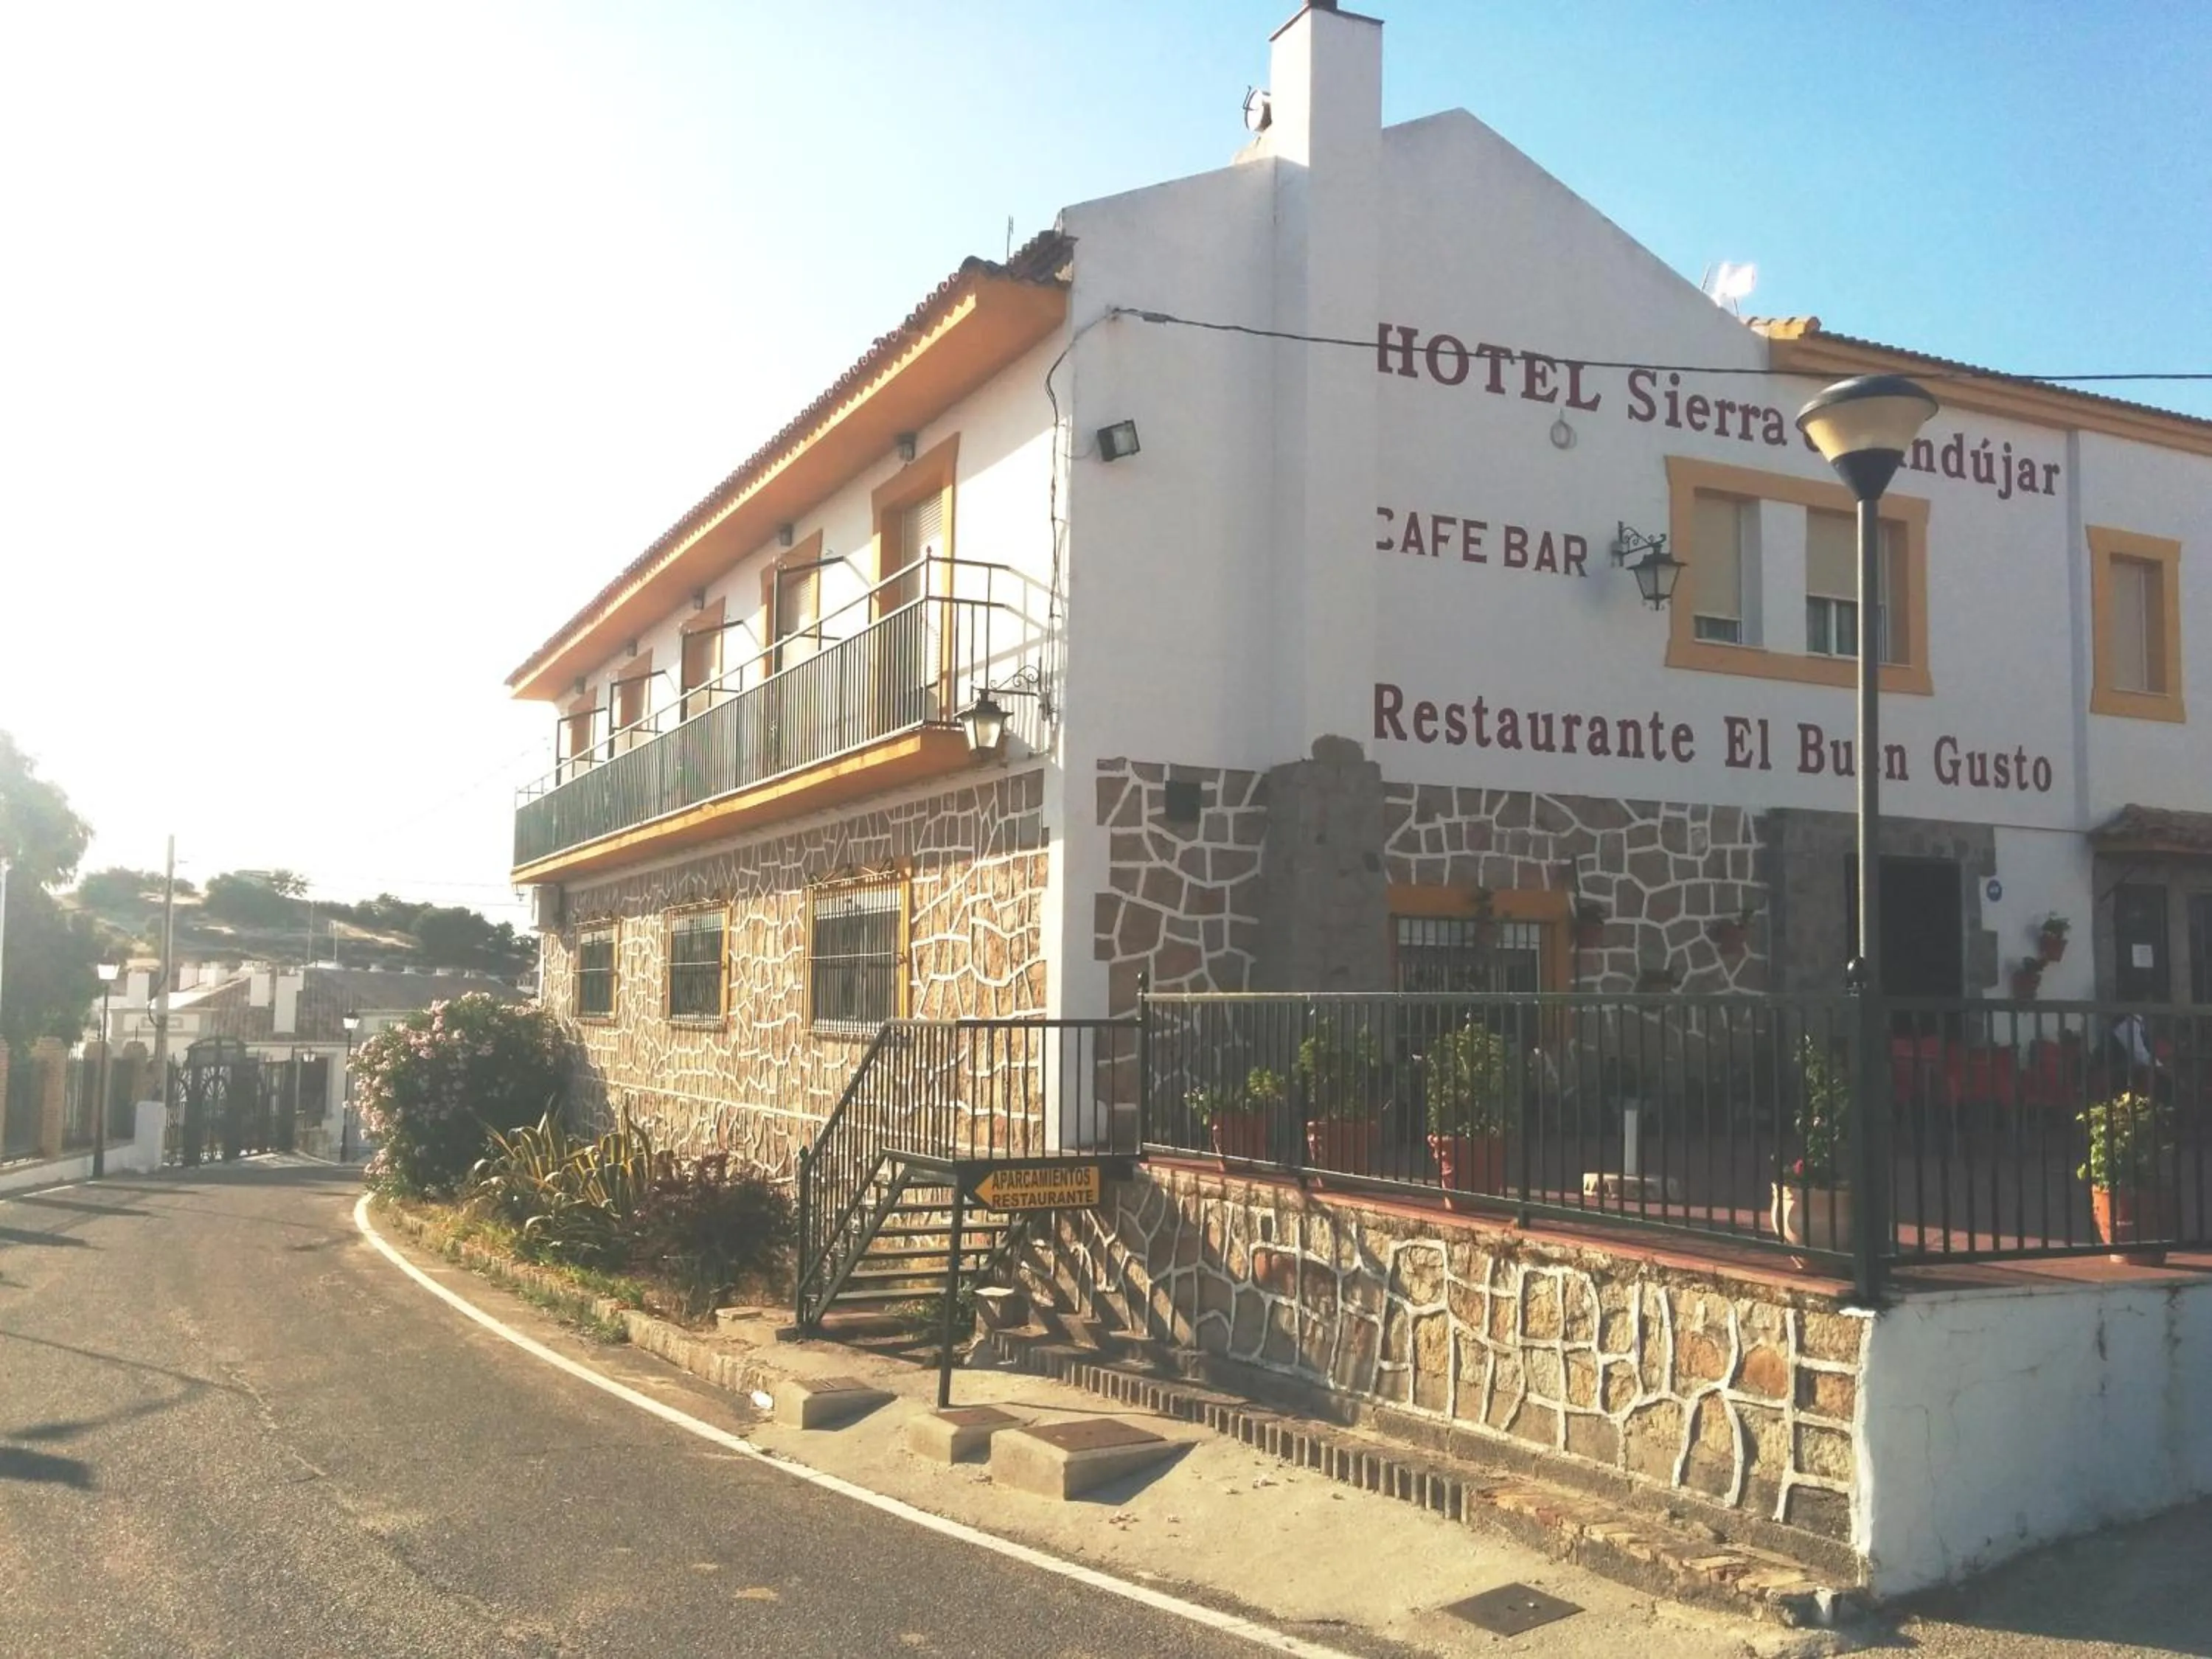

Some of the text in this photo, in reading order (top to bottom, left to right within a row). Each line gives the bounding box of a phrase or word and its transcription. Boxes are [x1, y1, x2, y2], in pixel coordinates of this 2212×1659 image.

[1377, 322, 2060, 499] HOTEL Sierra ndújar
[1503, 524, 1587, 577] BAR
[1374, 683, 2052, 792] Restaurante El Bun Gusto
[992, 1168, 1091, 1189] APARCAMIENTOS
[992, 1189, 1093, 1207] RESTAURANTE
